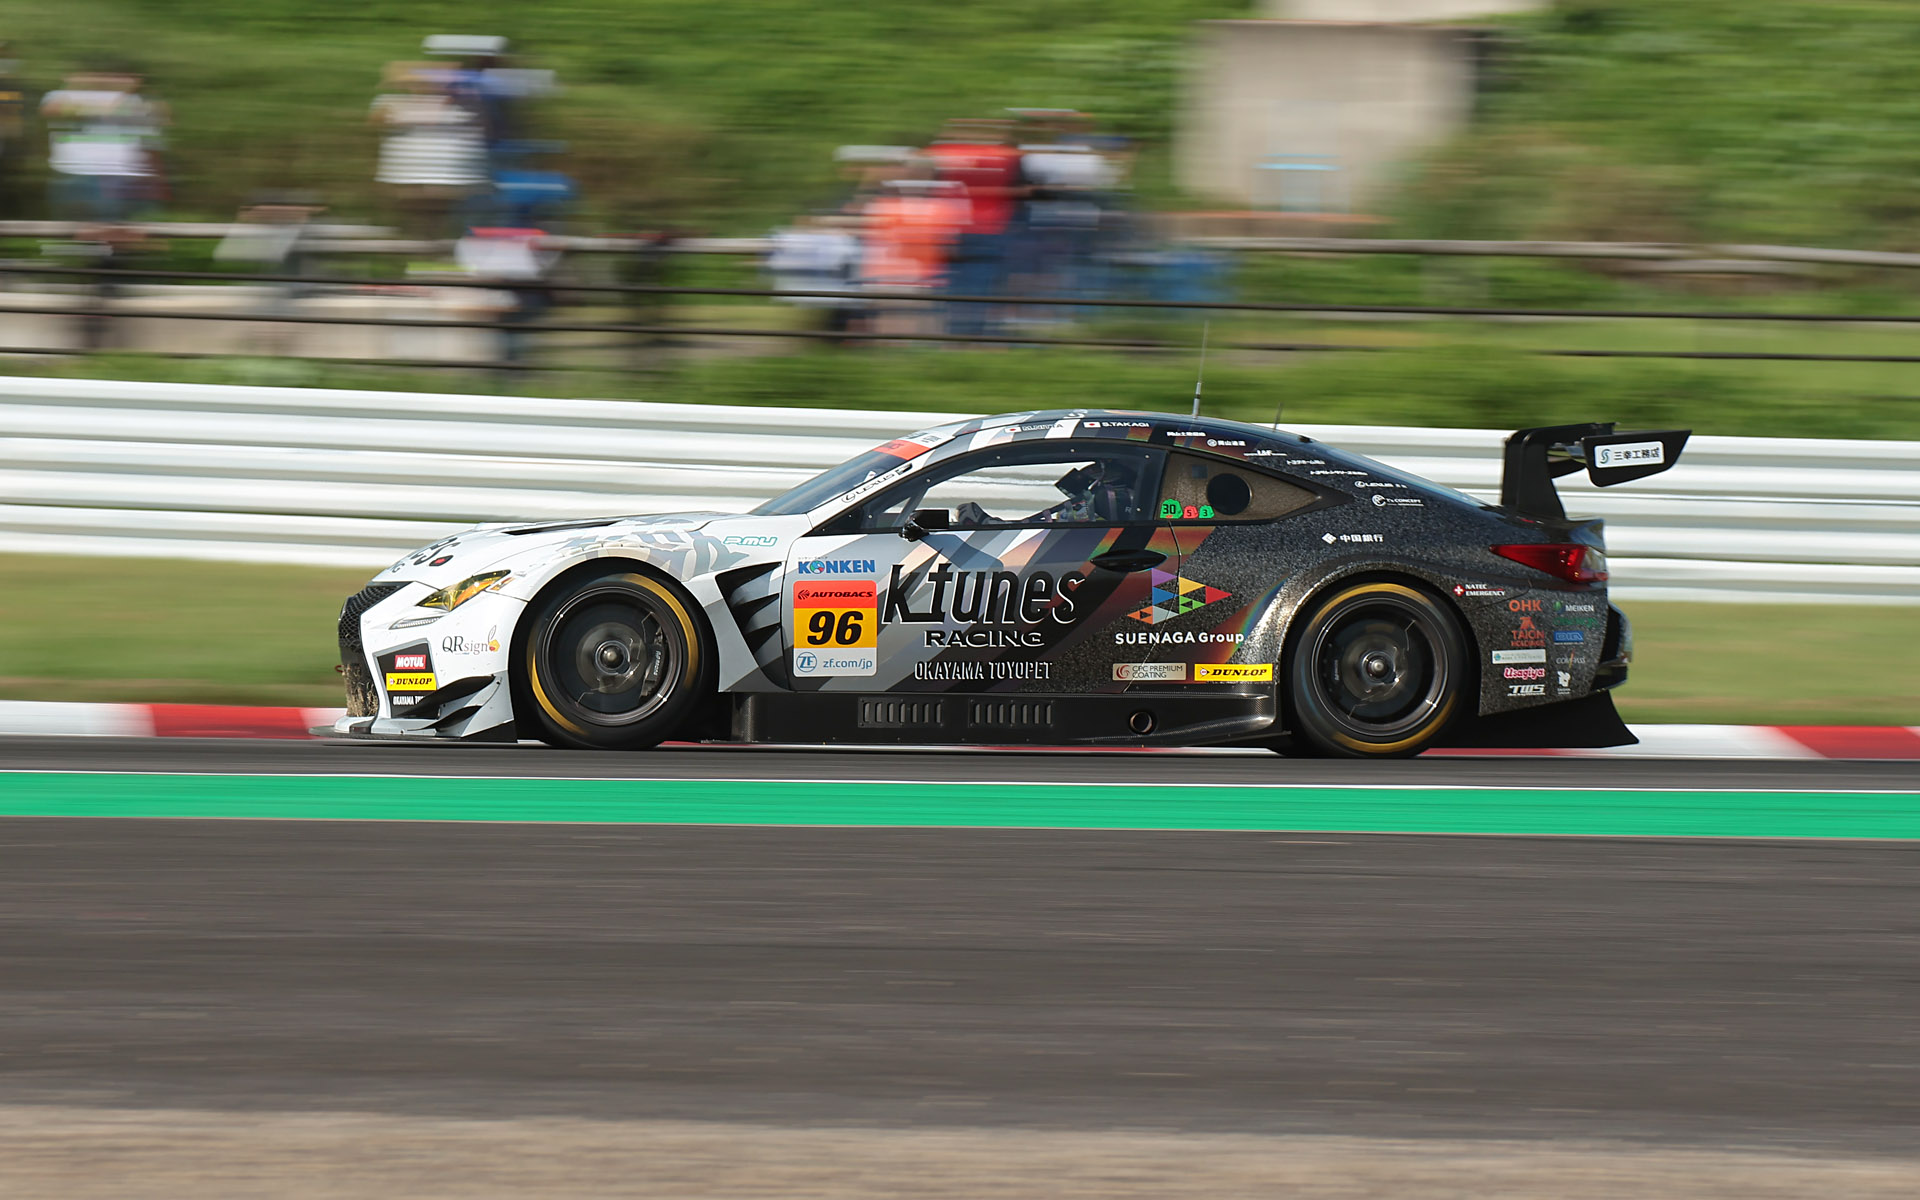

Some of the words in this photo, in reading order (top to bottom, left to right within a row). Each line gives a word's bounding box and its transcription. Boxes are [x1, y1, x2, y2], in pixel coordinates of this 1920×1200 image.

[856, 474, 894, 495] LEXUS
[1162, 503, 1176, 515] 30
[1186, 509, 1192, 517] 5
[1202, 509, 1208, 517] 3
[1508, 599, 1543, 612] OHK
[1565, 604, 1595, 612] MEIKEN
[807, 611, 863, 645] 96
[923, 630, 1045, 649] RACING
[1115, 631, 1196, 645] SUENAGA
[1198, 632, 1245, 646] Group
[1511, 630, 1545, 641] TAION
[442, 635, 488, 656] QRsign
[395, 656, 425, 668] MOTUL
[823, 658, 873, 670] zf.com/jp
[914, 660, 985, 681] OKAYAMA
[988, 660, 1053, 681] TOYOPET
[1132, 671, 1168, 679] COATING
[1212, 668, 1268, 677] DUNLOP
[1503, 667, 1546, 680] Usagiya
[396, 678, 432, 686] DUNLOP
[1508, 684, 1546, 693] TWS
